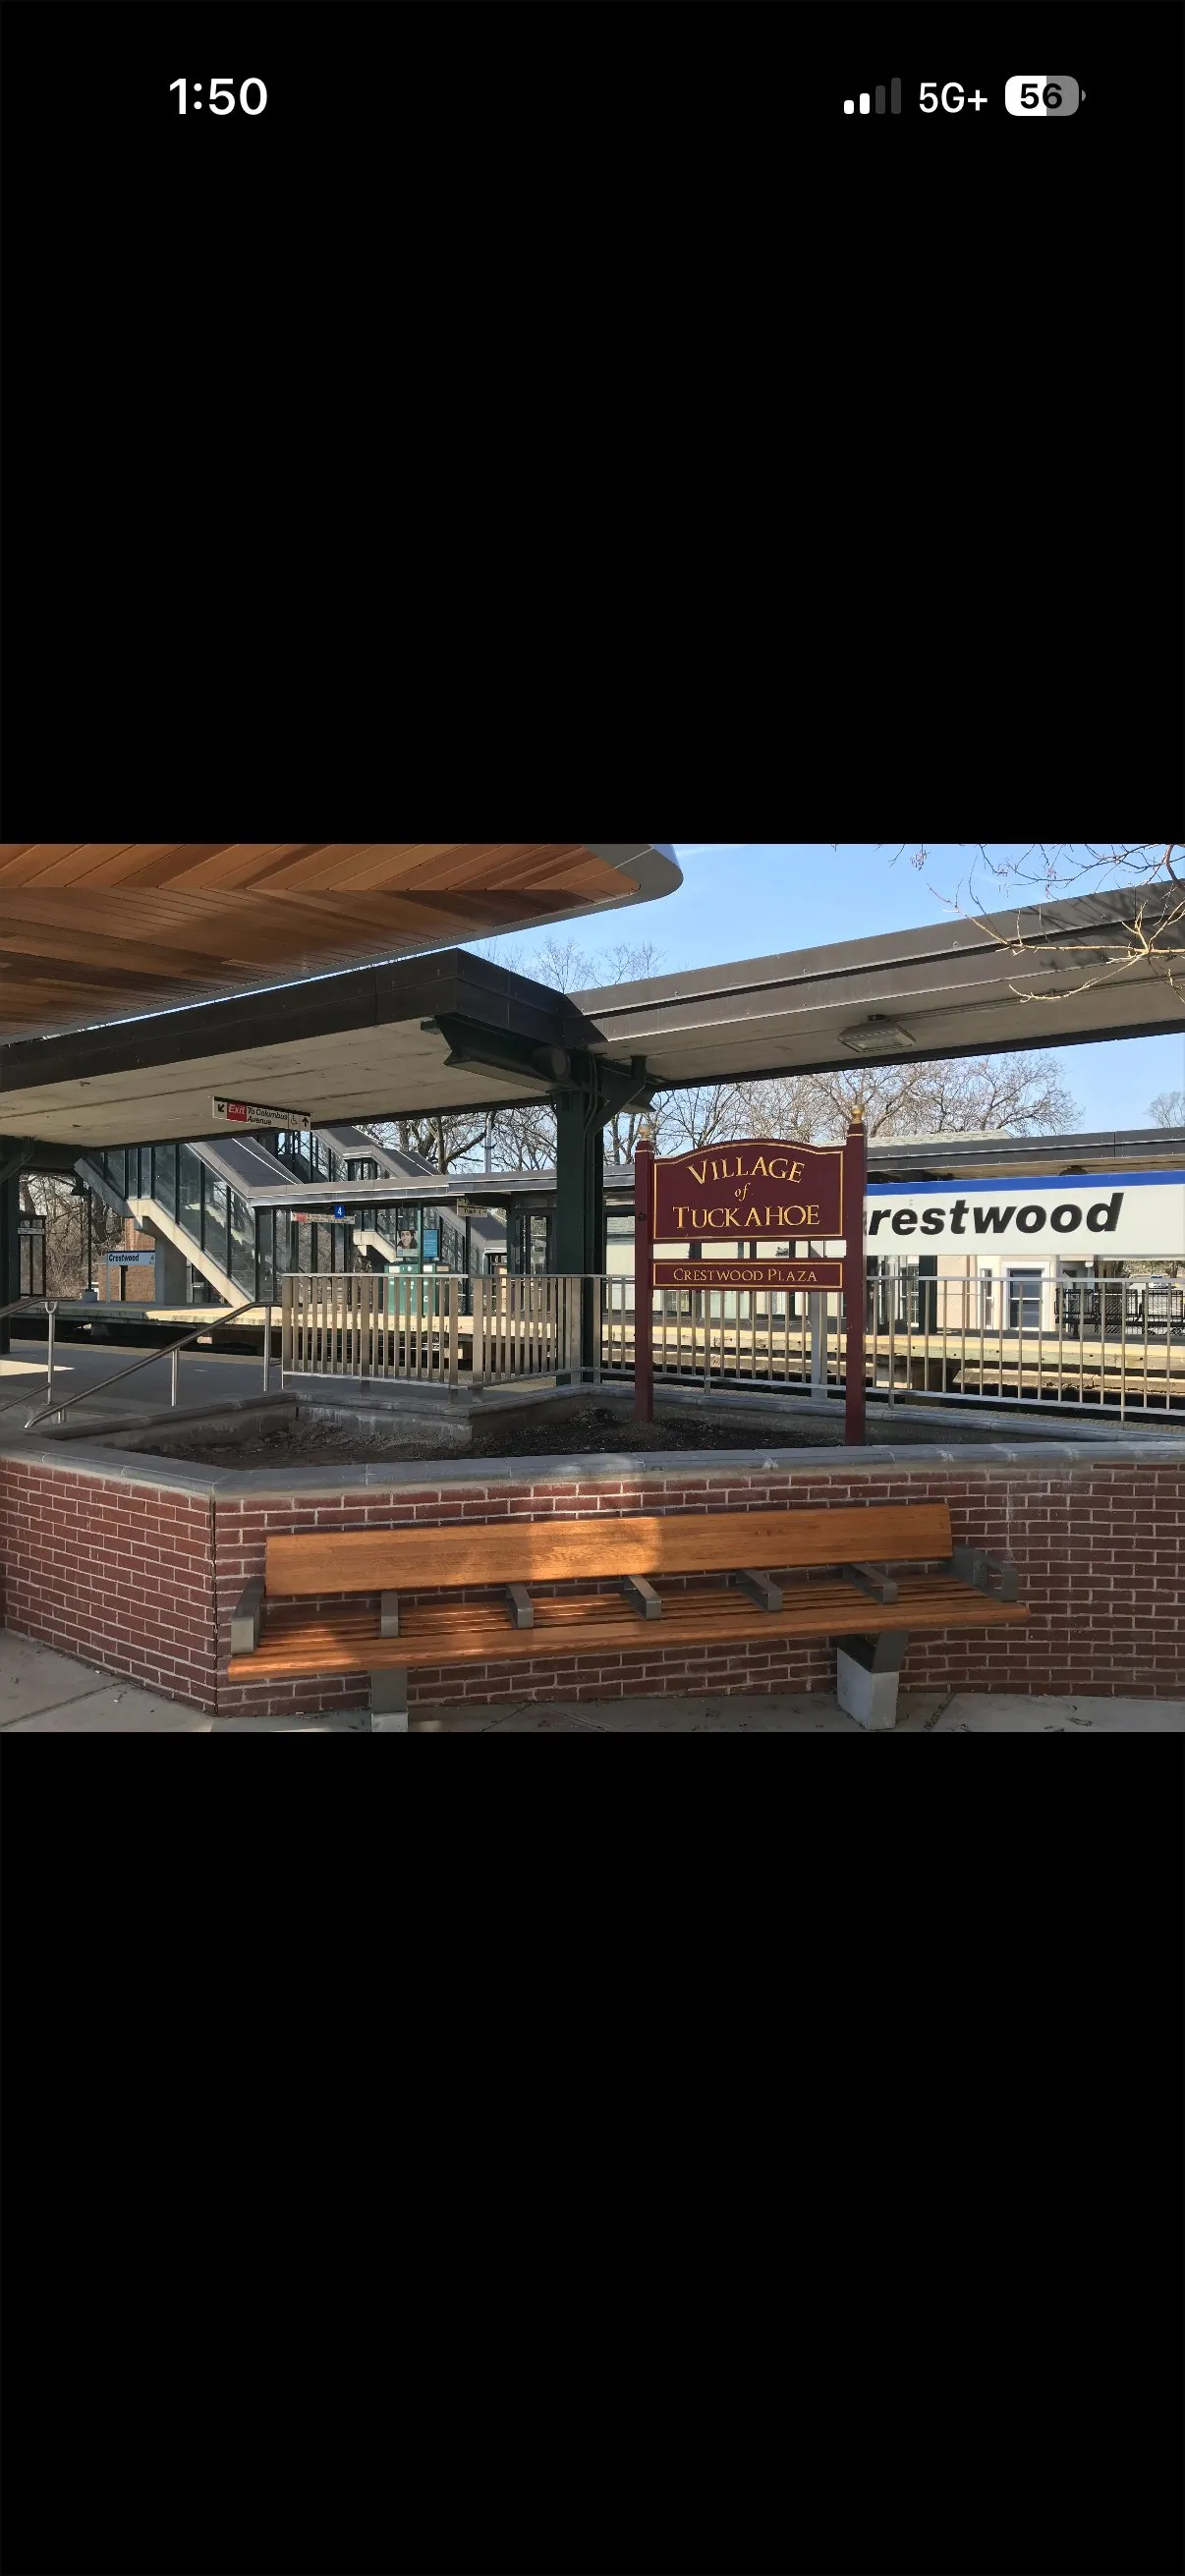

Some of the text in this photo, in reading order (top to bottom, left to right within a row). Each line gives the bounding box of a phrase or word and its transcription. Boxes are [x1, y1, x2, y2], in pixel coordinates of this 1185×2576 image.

[228, 1103, 246, 1115] Exit
[248, 1106, 288, 1120] To Columbus
[248, 1115, 272, 1126] Avenue
[686, 1155, 806, 1185] VILLAGE
[734, 1182, 752, 1202] of
[337, 1206, 342, 1216] 4
[672, 1204, 820, 1229] TUCKAHOE
[863, 1192, 1124, 1236] restwood
[108, 1253, 140, 1262] Crestwood
[673, 1268, 818, 1282] CRESTWOOD PLAZA
